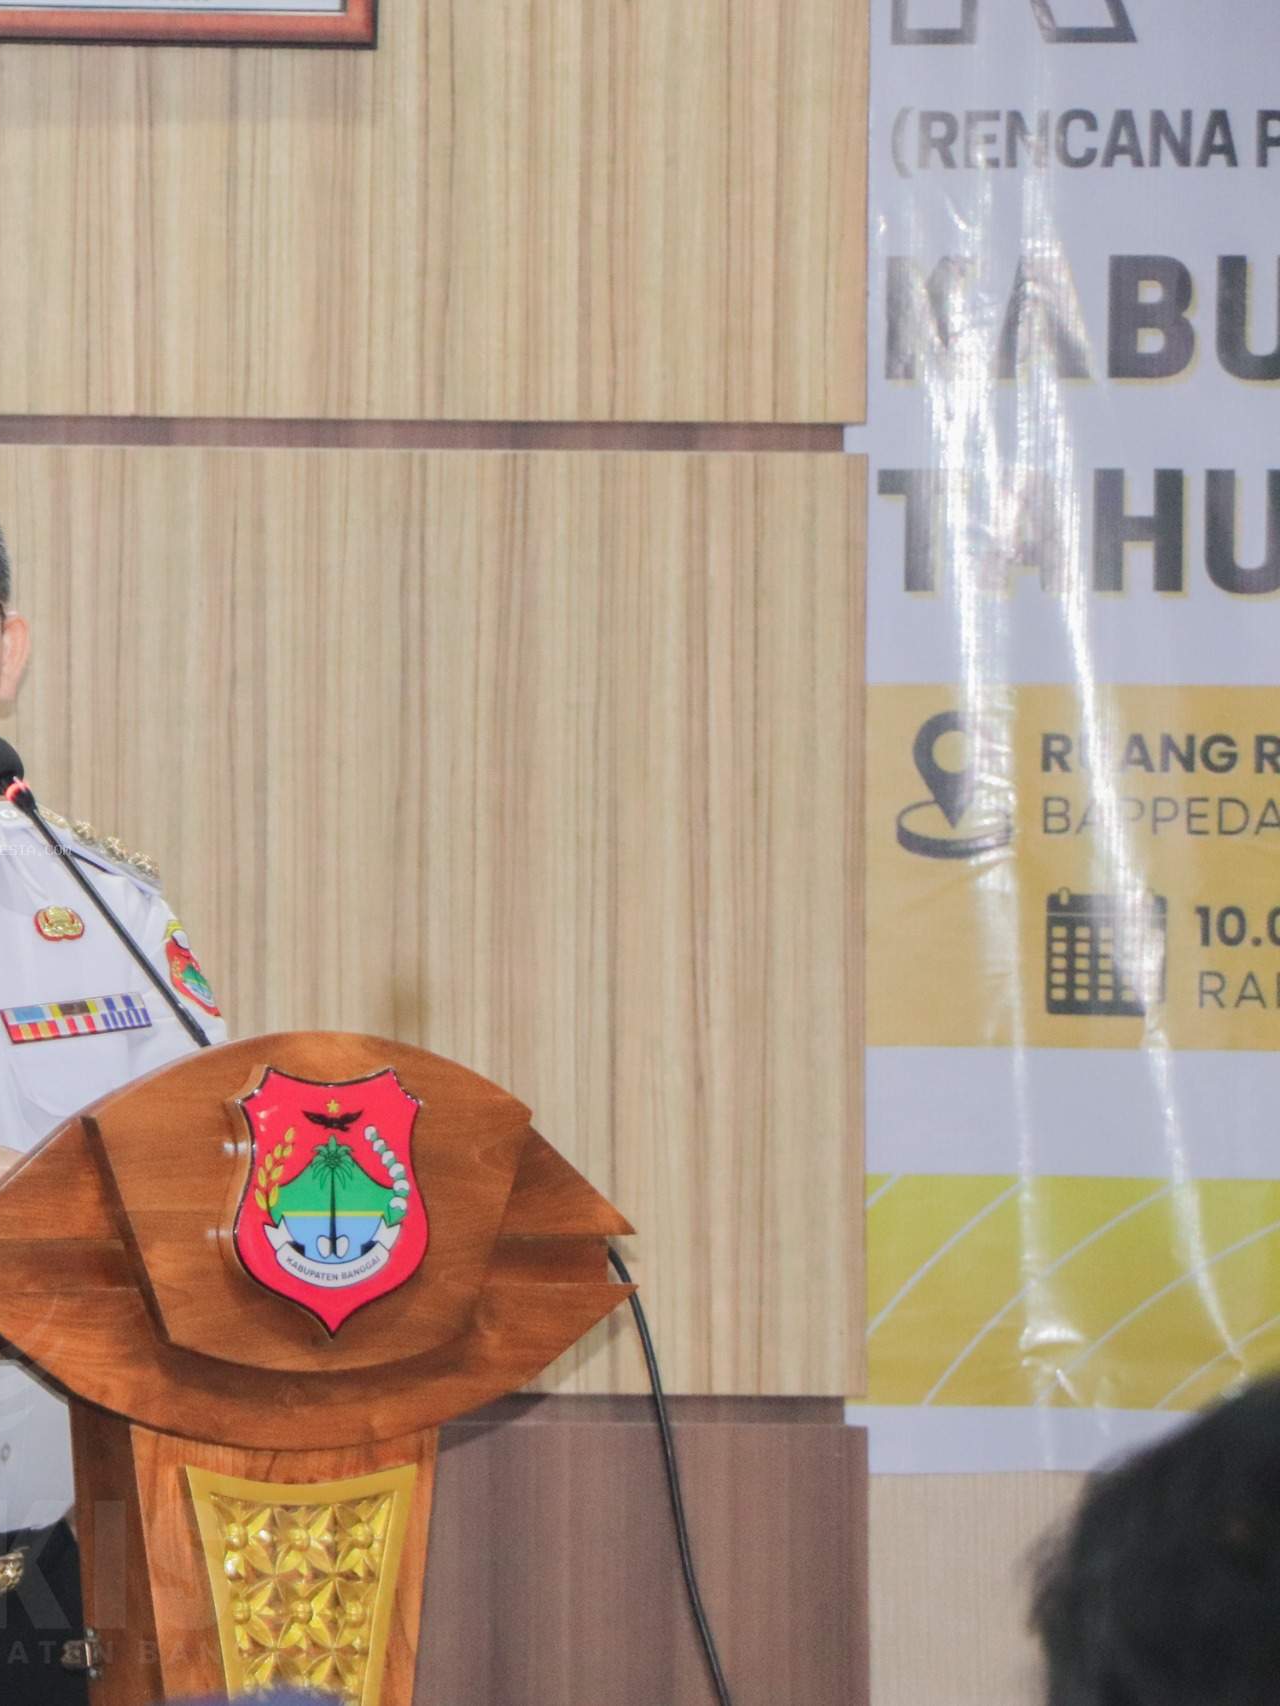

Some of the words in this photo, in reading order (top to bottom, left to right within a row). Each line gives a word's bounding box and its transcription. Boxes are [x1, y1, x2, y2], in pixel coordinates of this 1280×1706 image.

[891, 107, 1238, 178] (RENCANA
[1198, 971, 1280, 1009] RA
[285, 1256, 338, 1281] KABUPATEN
[340, 1255, 381, 1280] BANGGAI
